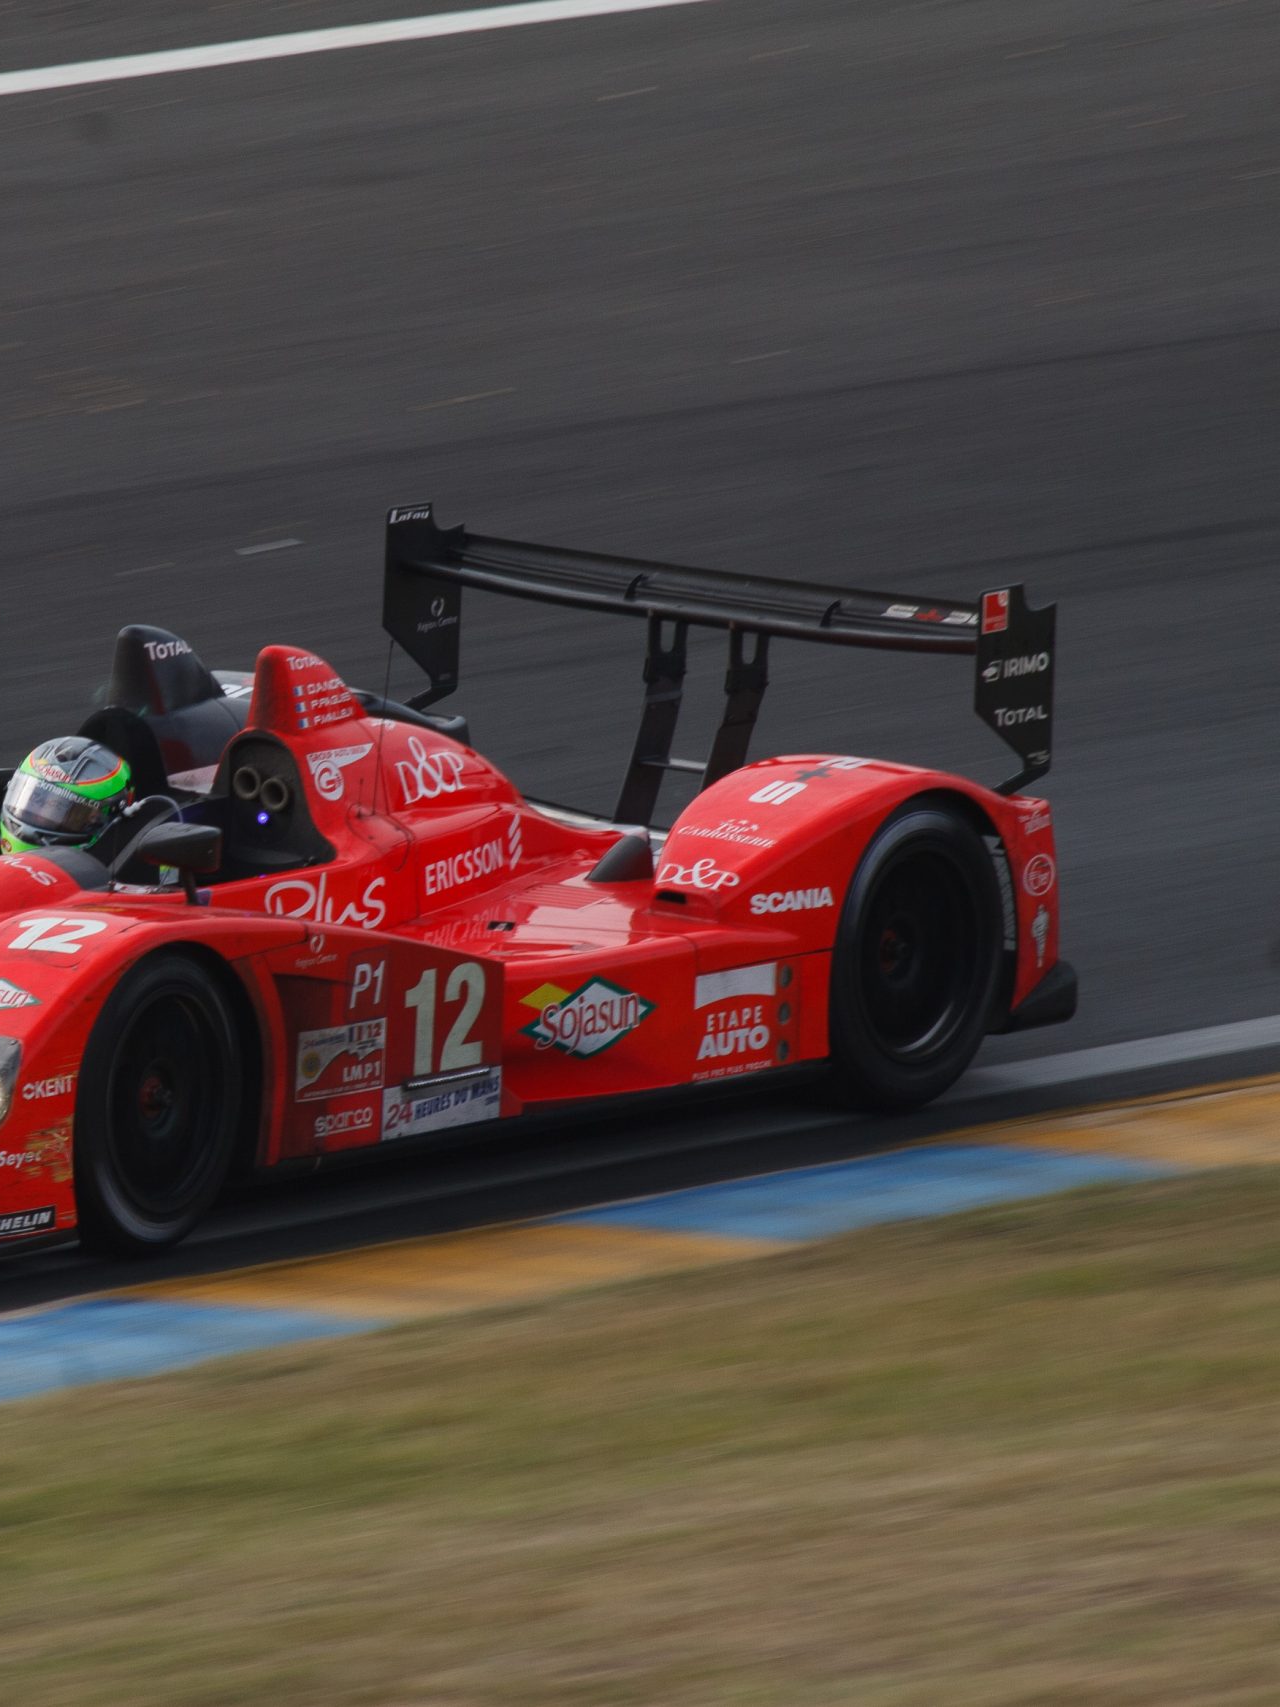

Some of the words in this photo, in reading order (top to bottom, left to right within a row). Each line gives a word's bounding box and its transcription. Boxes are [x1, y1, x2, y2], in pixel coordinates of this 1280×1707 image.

[143, 640, 192, 660] TOTAL
[1003, 652, 1049, 678] IRIMO
[994, 704, 1049, 727] TOTAL
[424, 838, 504, 896] ERICSSON
[655, 858, 741, 891] D&P
[749, 887, 834, 915] SCANIA
[8, 917, 108, 954] 12
[349, 960, 385, 1010] P1
[405, 961, 486, 1077] 12
[706, 1005, 763, 1032] ETAPE
[696, 1024, 770, 1061] AUTO
[314, 1106, 373, 1134] sparco
[384, 1098, 413, 1132] 24
